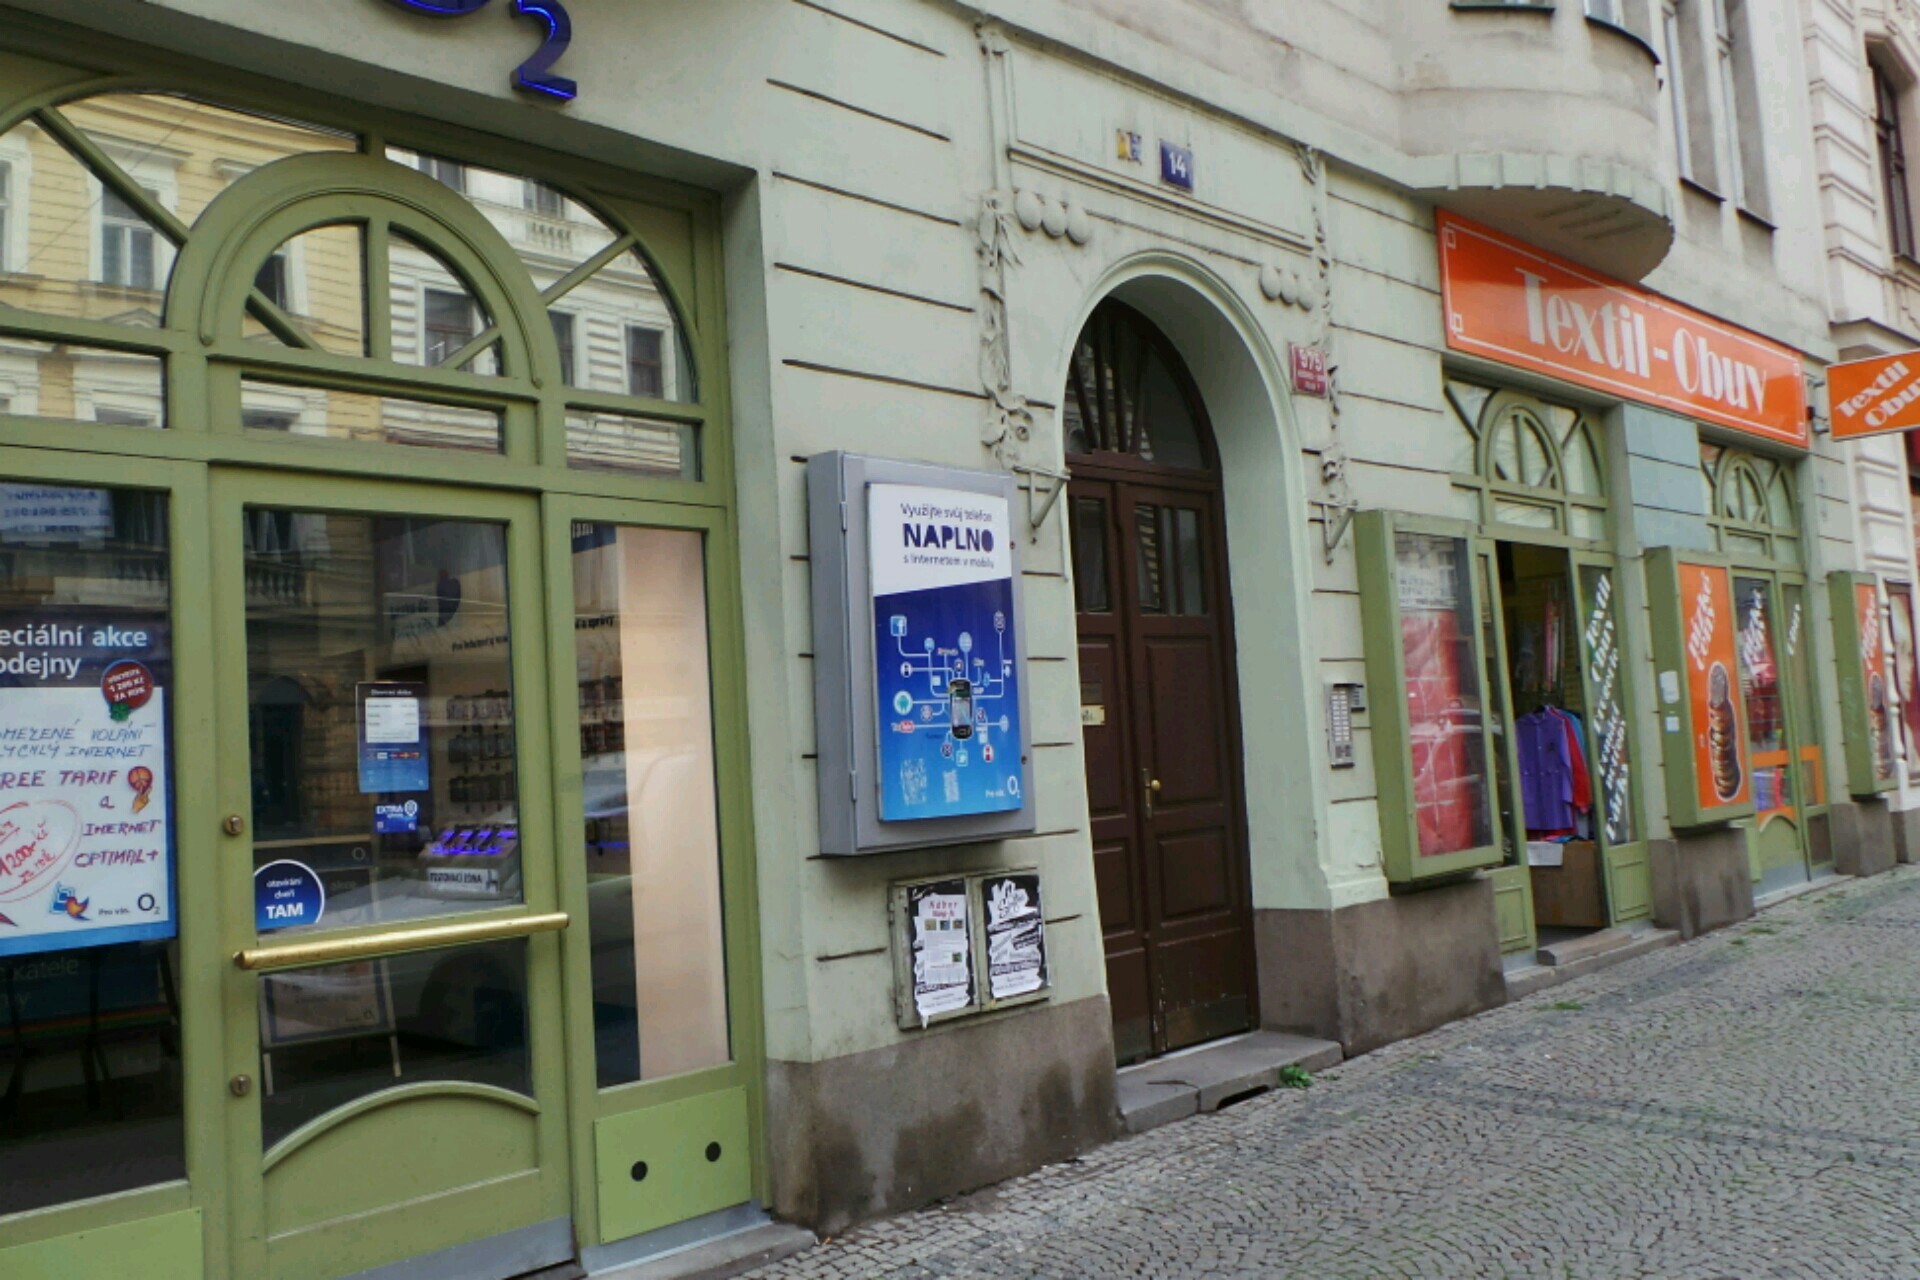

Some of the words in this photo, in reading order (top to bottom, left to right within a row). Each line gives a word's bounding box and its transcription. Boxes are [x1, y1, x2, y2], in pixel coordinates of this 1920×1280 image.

[1168, 151, 1186, 178] 14
[1834, 361, 1909, 417] Textil
[903, 523, 994, 553] NAPLNO
[92, 625, 147, 646] akce
[58, 770, 118, 787] TARIF
[266, 902, 304, 919] TAM
